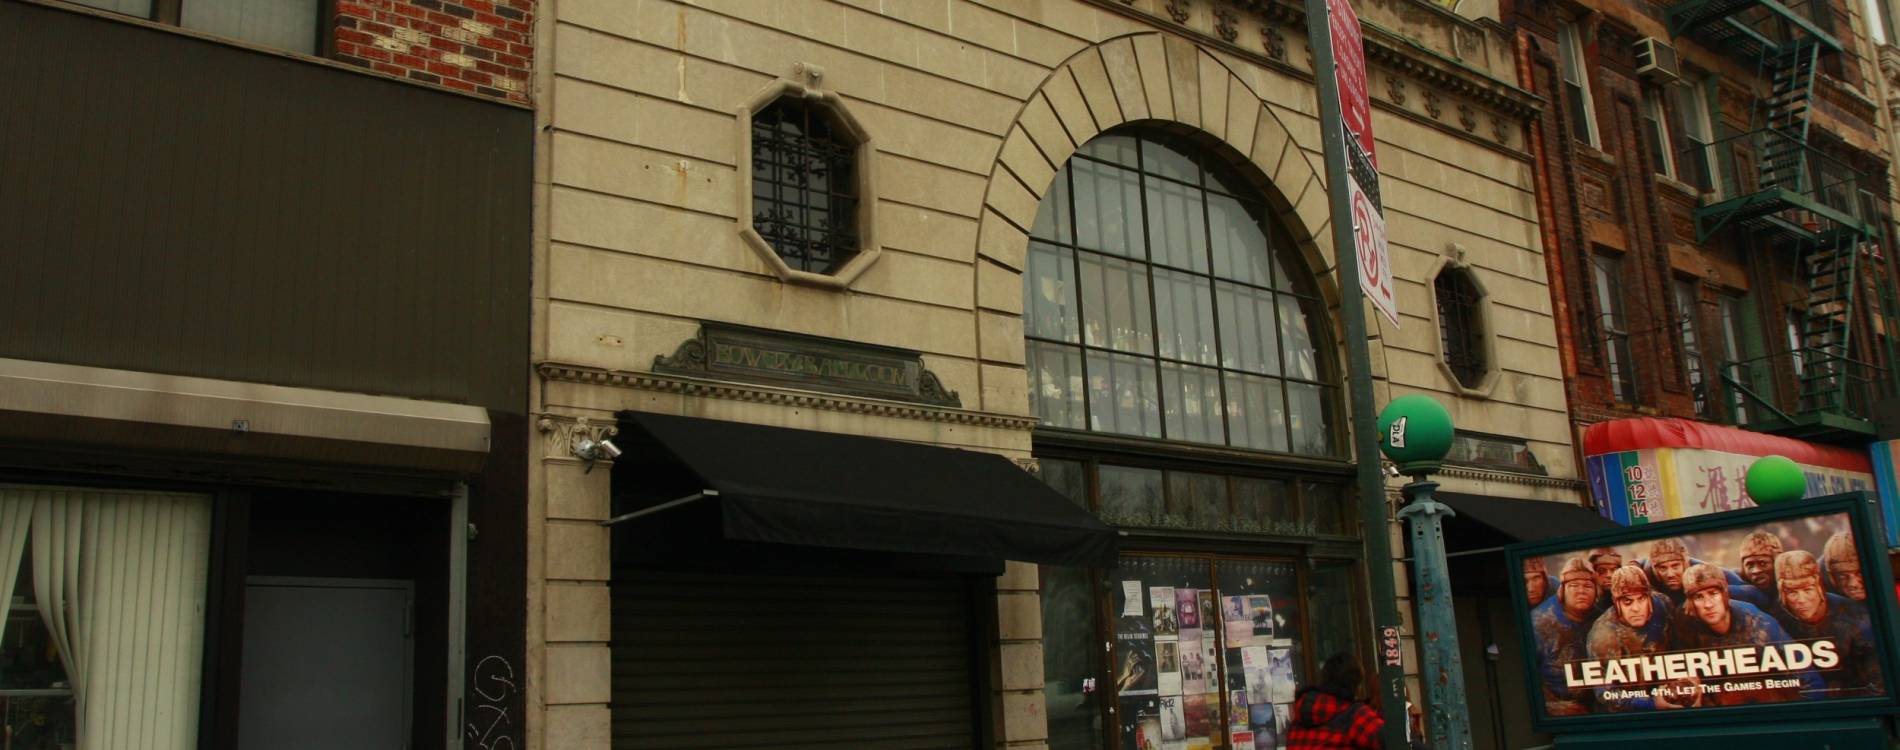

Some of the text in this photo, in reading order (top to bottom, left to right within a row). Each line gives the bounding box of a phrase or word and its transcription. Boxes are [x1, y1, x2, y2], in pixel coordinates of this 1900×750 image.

[1625, 466, 1643, 481] 10
[1628, 484, 1646, 499] 12
[1631, 502, 1649, 517] 14
[1383, 628, 1400, 666] 1849
[1564, 640, 1839, 687] LEATHERHEADS
